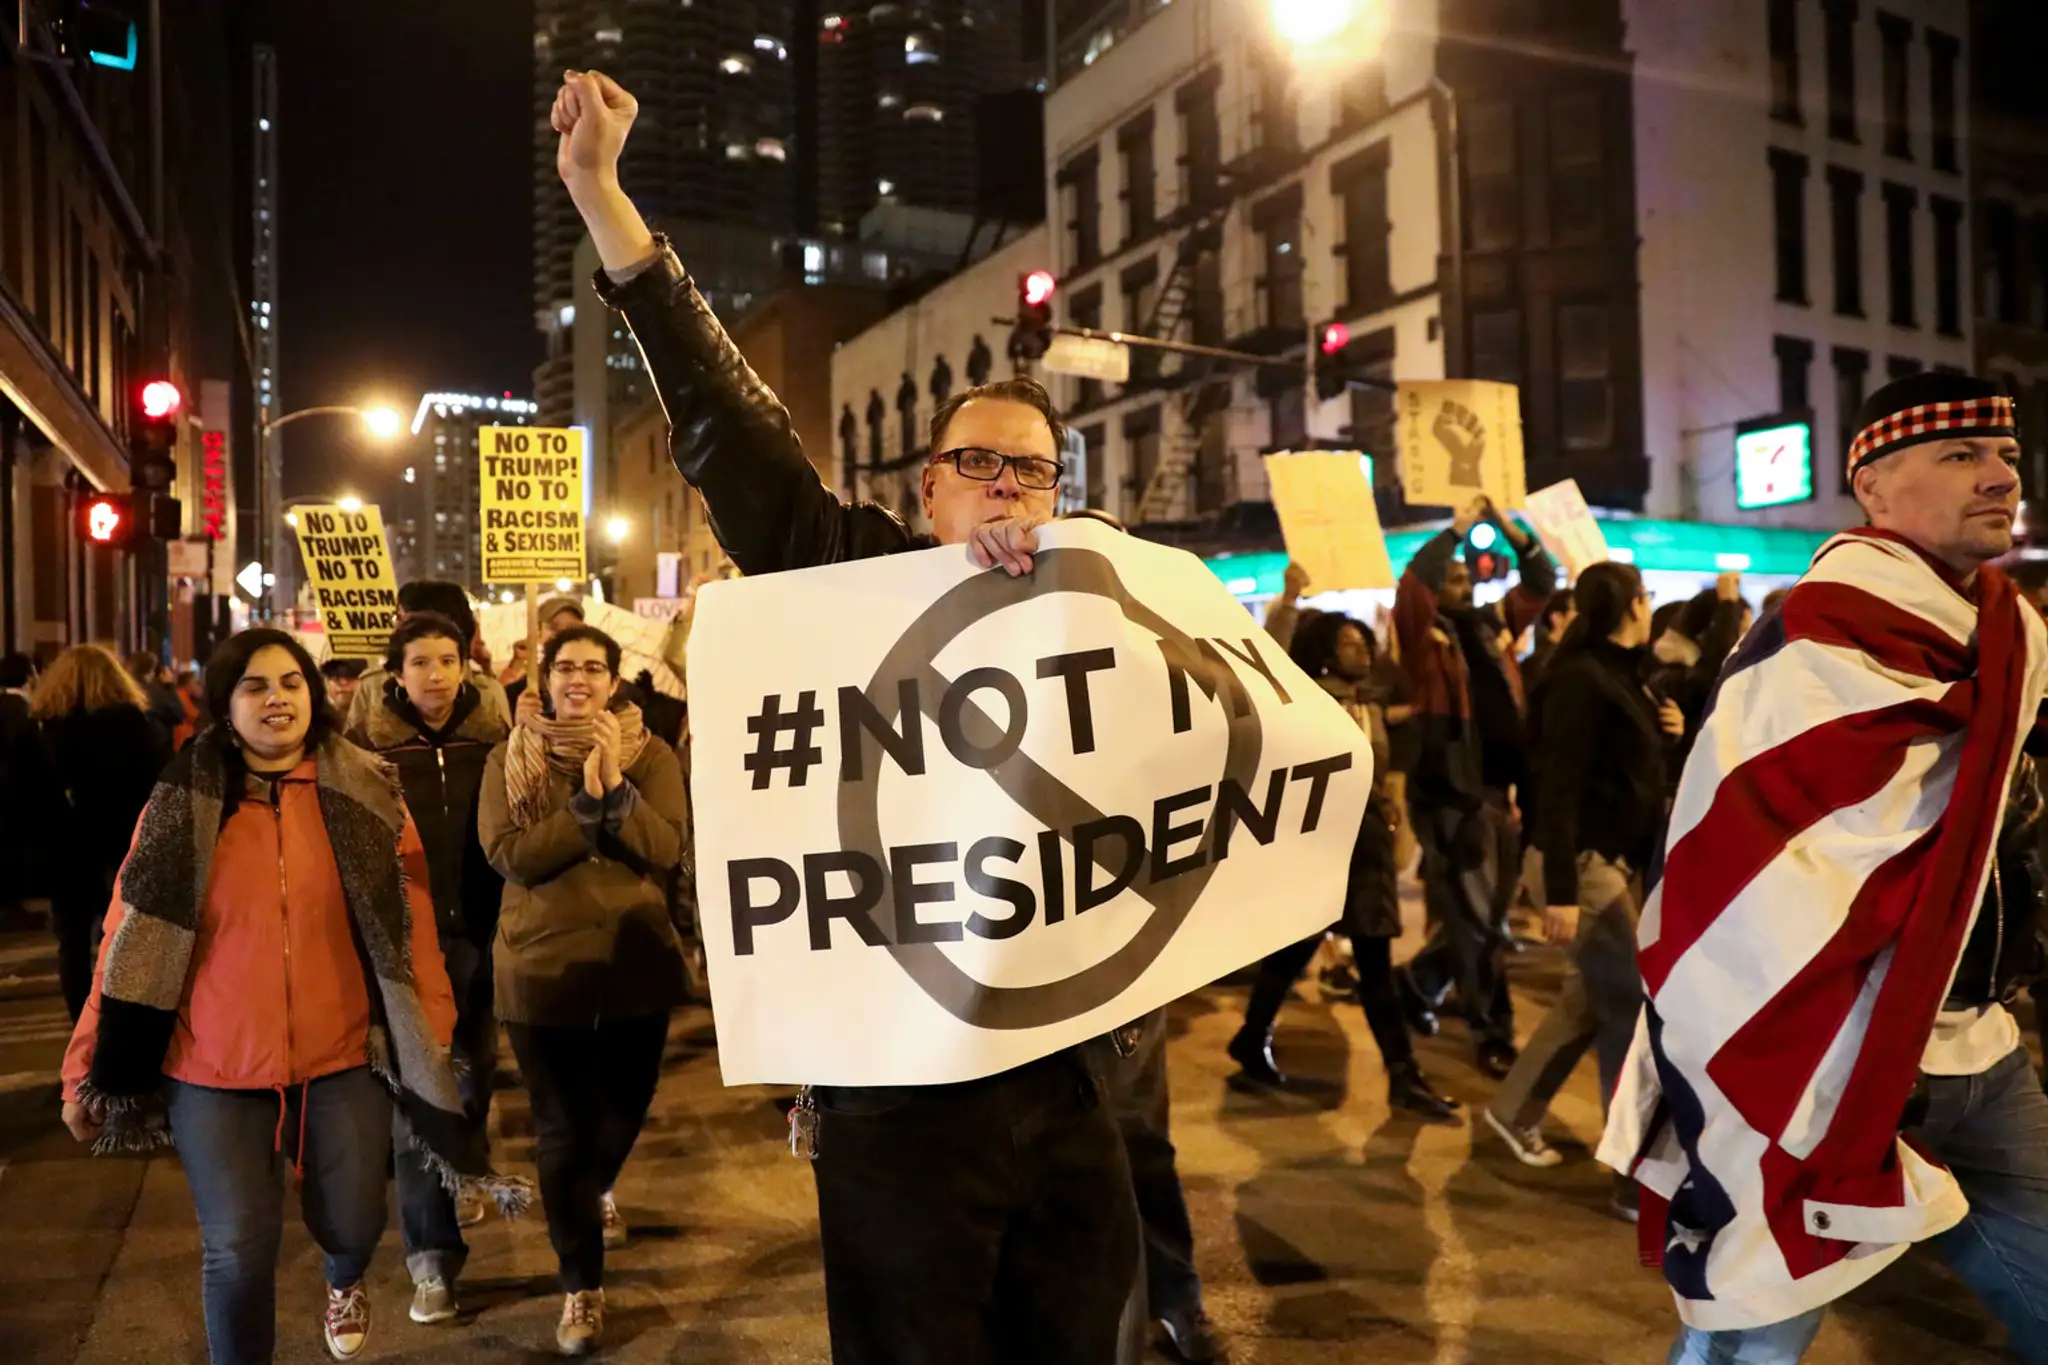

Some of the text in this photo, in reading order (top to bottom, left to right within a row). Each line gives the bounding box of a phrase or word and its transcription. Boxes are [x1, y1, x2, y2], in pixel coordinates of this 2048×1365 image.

[495, 432, 567, 454] NO TO
[485, 456, 578, 478] TRUMP!
[201, 431, 225, 541] PARKING
[496, 479, 569, 500] NO TO
[305, 510, 368, 534] NO TO
[486, 508, 579, 529] RACISM
[302, 534, 383, 557] TRUMP!
[486, 531, 580, 552] & SEXISM!
[316, 559, 380, 581] NO TO
[318, 588, 396, 608] RACISM
[326, 611, 397, 630] & WAR
[639, 602, 674, 619] LOV
[743, 637, 1294, 790] #NOT MY
[727, 752, 1353, 956] PRESIDENT
